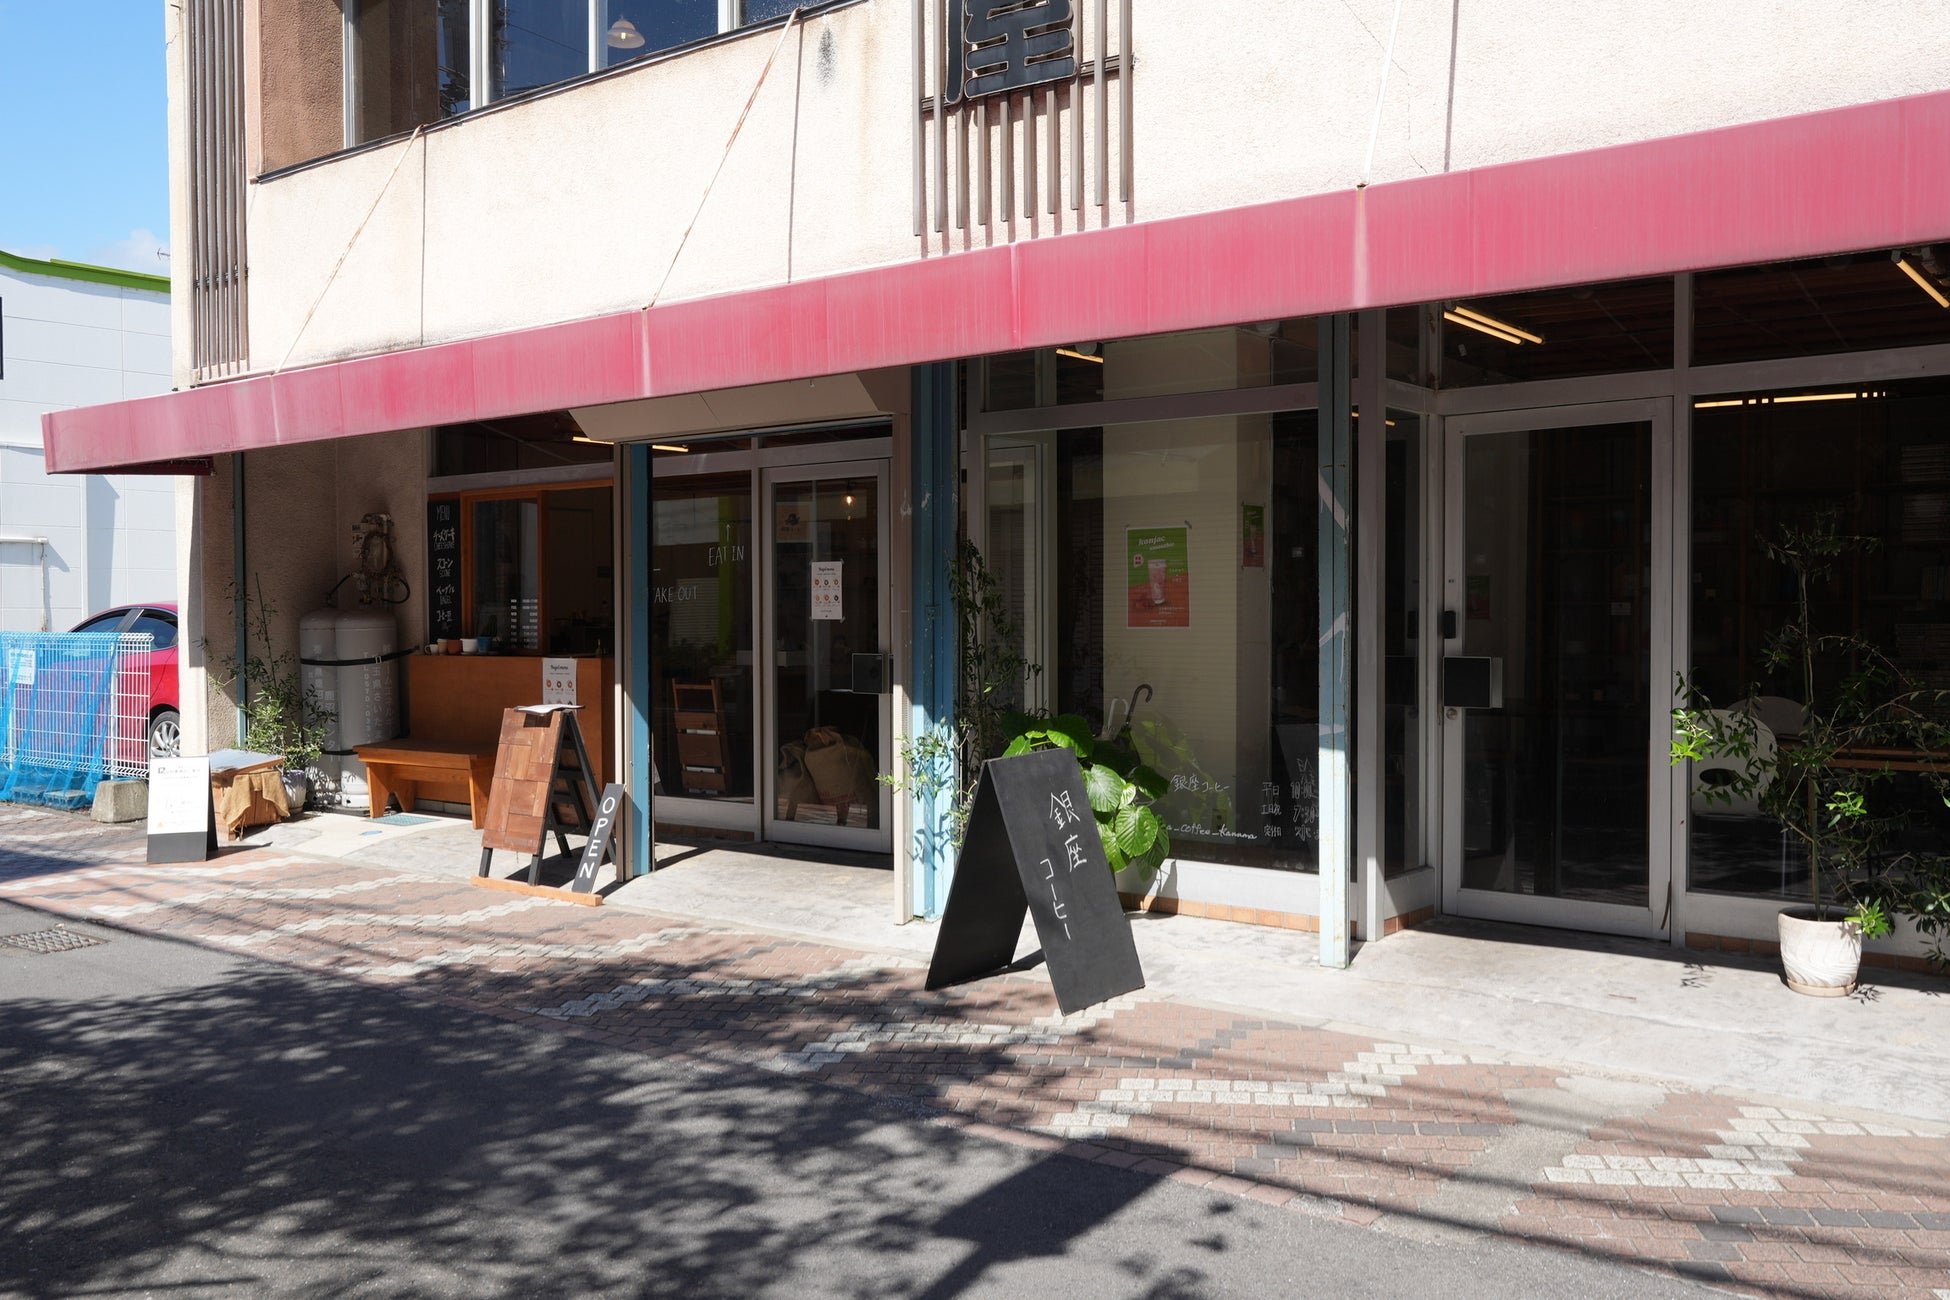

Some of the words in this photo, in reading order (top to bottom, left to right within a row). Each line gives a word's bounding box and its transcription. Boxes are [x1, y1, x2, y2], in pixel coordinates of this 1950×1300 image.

[708, 545, 728, 567] EAT
[731, 545, 745, 562] IN
[677, 586, 698, 601] OUT
[1170, 773, 1231, 793] 銀座コーヒー
[1261, 781, 1280, 798] 平日
[579, 796, 617, 880] OPEN
[1049, 789, 1088, 873] 銀座
[1039, 858, 1072, 941] コーヒー
